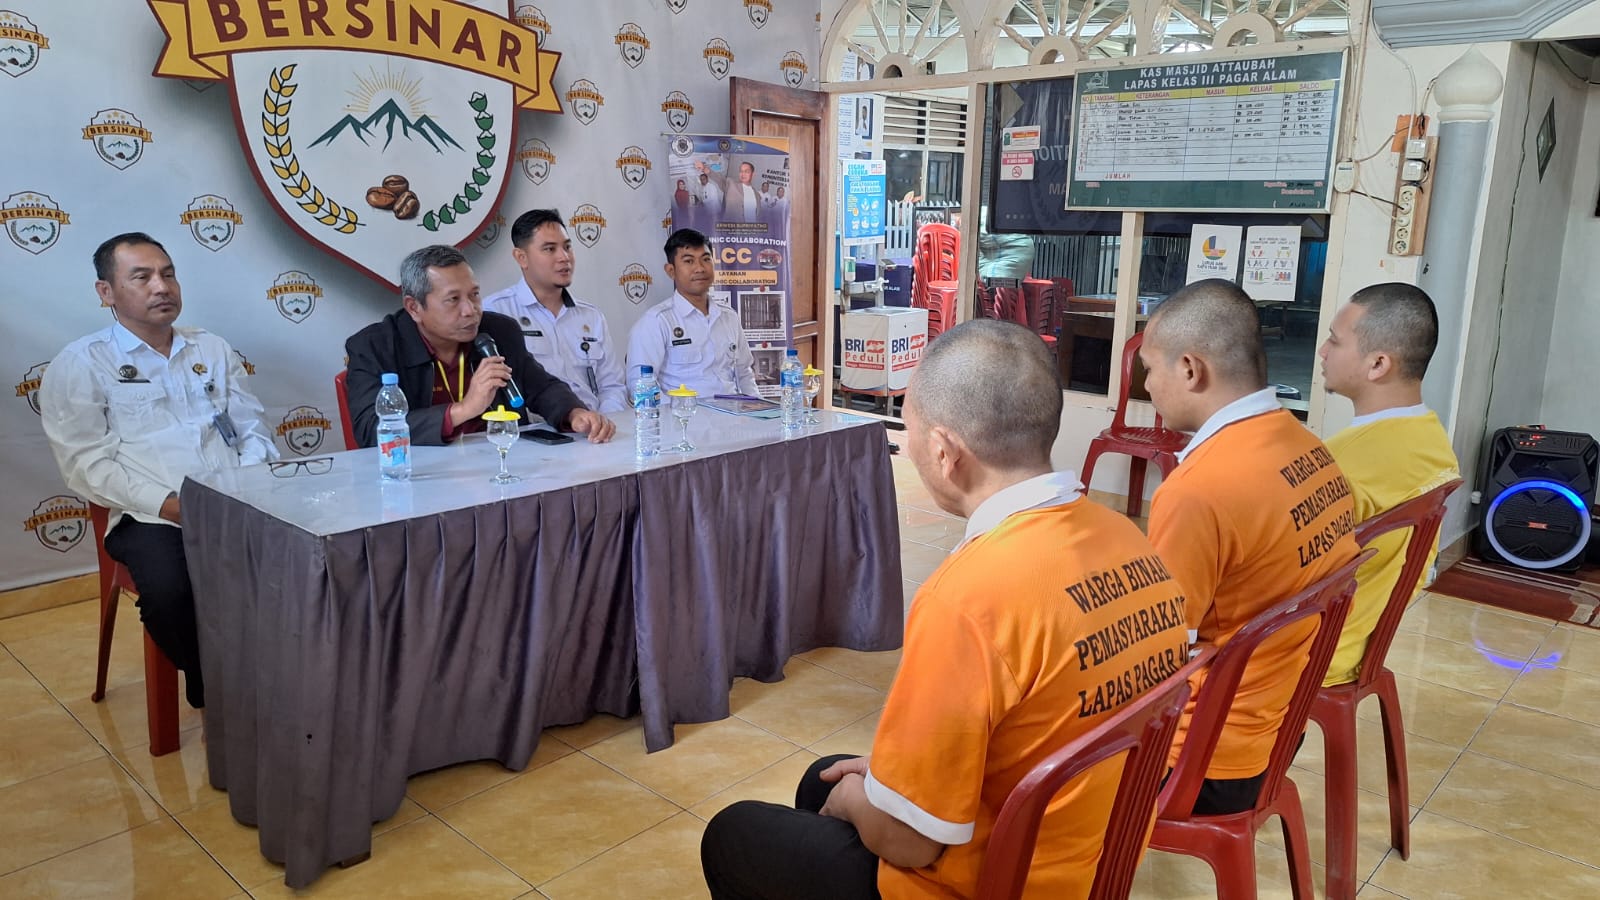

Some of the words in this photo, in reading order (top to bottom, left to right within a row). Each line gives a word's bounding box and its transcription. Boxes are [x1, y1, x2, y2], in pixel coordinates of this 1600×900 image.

[210, 0, 522, 74] BERSINAR
[1140, 67, 1164, 78] KAS
[1166, 64, 1208, 76] MASJID
[1212, 59, 1276, 72] ATTAUBAH
[1124, 78, 1157, 90] LAPAS
[1162, 76, 1198, 88] KELAS
[1202, 74, 1215, 86] III
[1219, 72, 1258, 84] PAGAR
[1263, 68, 1297, 81] ALAM
[90, 126, 144, 136] BERSINAR
[2, 209, 61, 219] BERSINAR
[188, 210, 235, 220] BERSINAR
[726, 237, 786, 246] COLLABORATION
[273, 285, 315, 295] BERSINAR
[845, 338, 864, 352] BRI
[892, 336, 909, 354] BRI
[845, 352, 885, 363] Peduli
[283, 419, 325, 431] BERSINAR
[1280, 453, 1318, 488] WARGA
[33, 510, 89, 525] BERSINAR
[1298, 527, 1335, 568] LAPAS
[1065, 568, 1128, 614] WARGA
[1078, 670, 1132, 718] LAPAS
[1134, 648, 1179, 694] PAGAR
